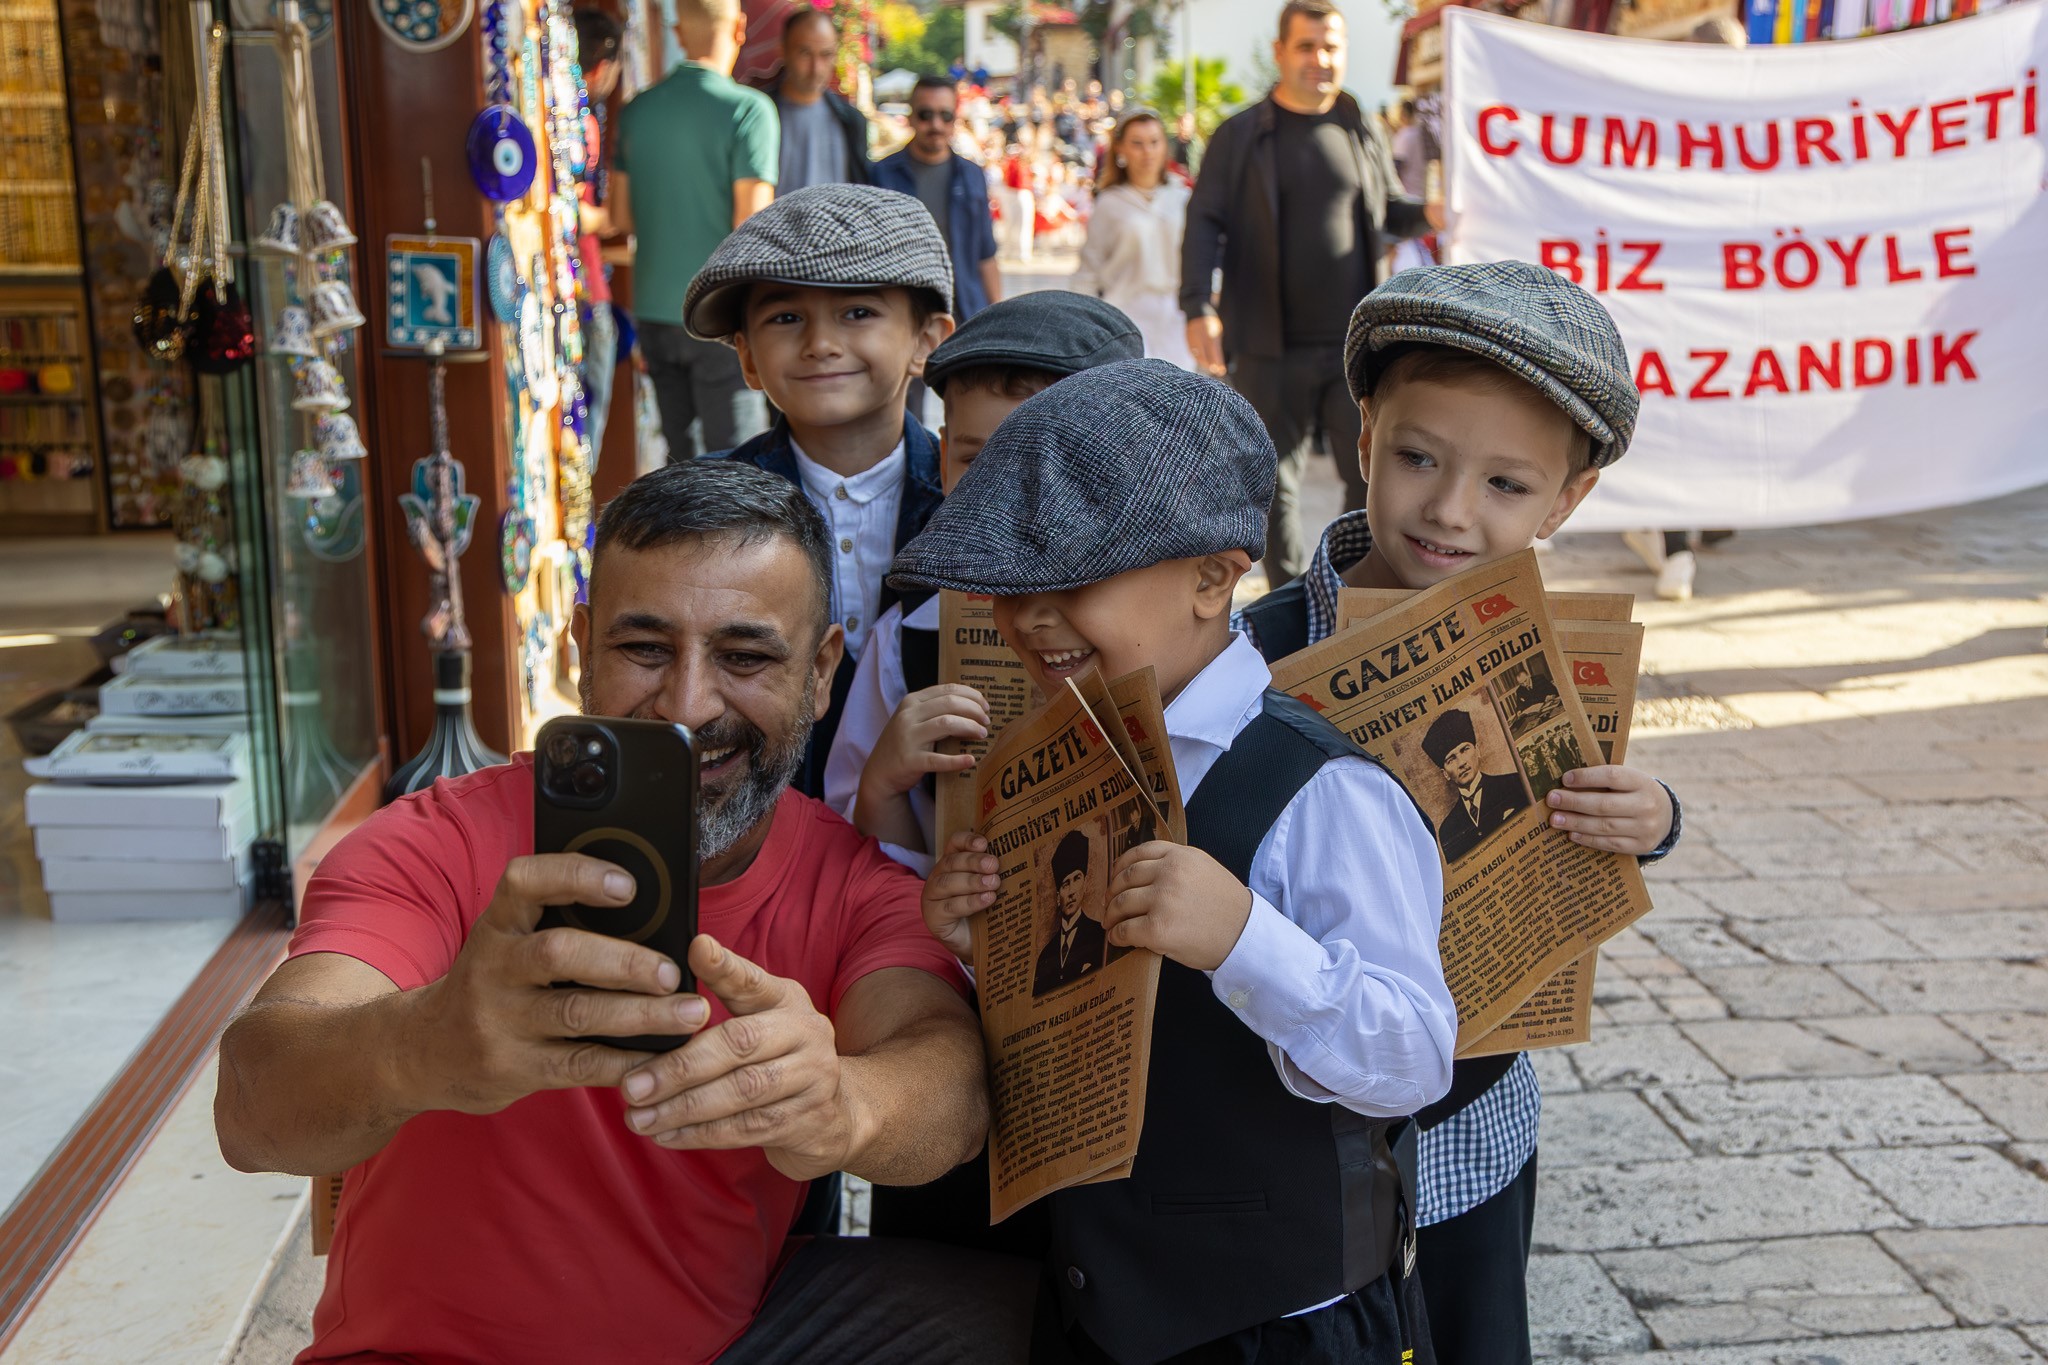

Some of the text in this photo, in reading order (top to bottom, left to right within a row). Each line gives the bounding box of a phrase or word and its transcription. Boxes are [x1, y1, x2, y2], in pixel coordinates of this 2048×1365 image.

[1478, 70, 2036, 172] CUMHURİYETİ
[1540, 229, 1976, 293] BİZ BÖYLE
[1636, 331, 1980, 401] AZANDIK
[1330, 613, 1464, 700] GAZETE
[1346, 624, 1541, 750] URİYET İLAN EDİLDİ
[1384, 690, 1396, 699] HER
[1000, 726, 1088, 800] GAZETE
[987, 808, 1059, 857] MHURİYET
[1064, 788, 1097, 821] İLAN
[1481, 855, 1506, 878] NASIL
[1506, 836, 1527, 857] İLAN
[1528, 821, 1551, 840] EDİL
[1452, 927, 1461, 936] 28
[1464, 915, 1479, 928] Ekim
[1482, 900, 1497, 914] 1923
[1521, 869, 1536, 884] yakın
[1457, 886, 1490, 912] düşmandan
[1463, 889, 1499, 919] cumhuriyetin
[1517, 856, 1540, 876] üzerinde
[1540, 867, 1553, 878] ilan
[1475, 924, 1506, 951] Cumhuriyet
[1567, 865, 1592, 880] Türkiye
[1492, 933, 1510, 949] Meclis
[1534, 898, 1550, 913] kabul
[1528, 910, 1549, 927] Türkiye
[1550, 885, 1589, 910] Cumhuriyeti
[1452, 980, 1477, 998] kurulan
[1479, 961, 1500, 979] Türkiye
[1556, 887, 1604, 916] Cumhurbaşkanı
[1457, 941, 1474, 954] Ekim
[1475, 926, 1490, 941] 1923
[1487, 960, 1514, 984] egemenlik
[1467, 1010, 1479, 1020] hak
[1555, 932, 1575, 947] kanun
[1046, 1011, 1072, 1028] NASIL
[1072, 1002, 1090, 1018] İLAN
